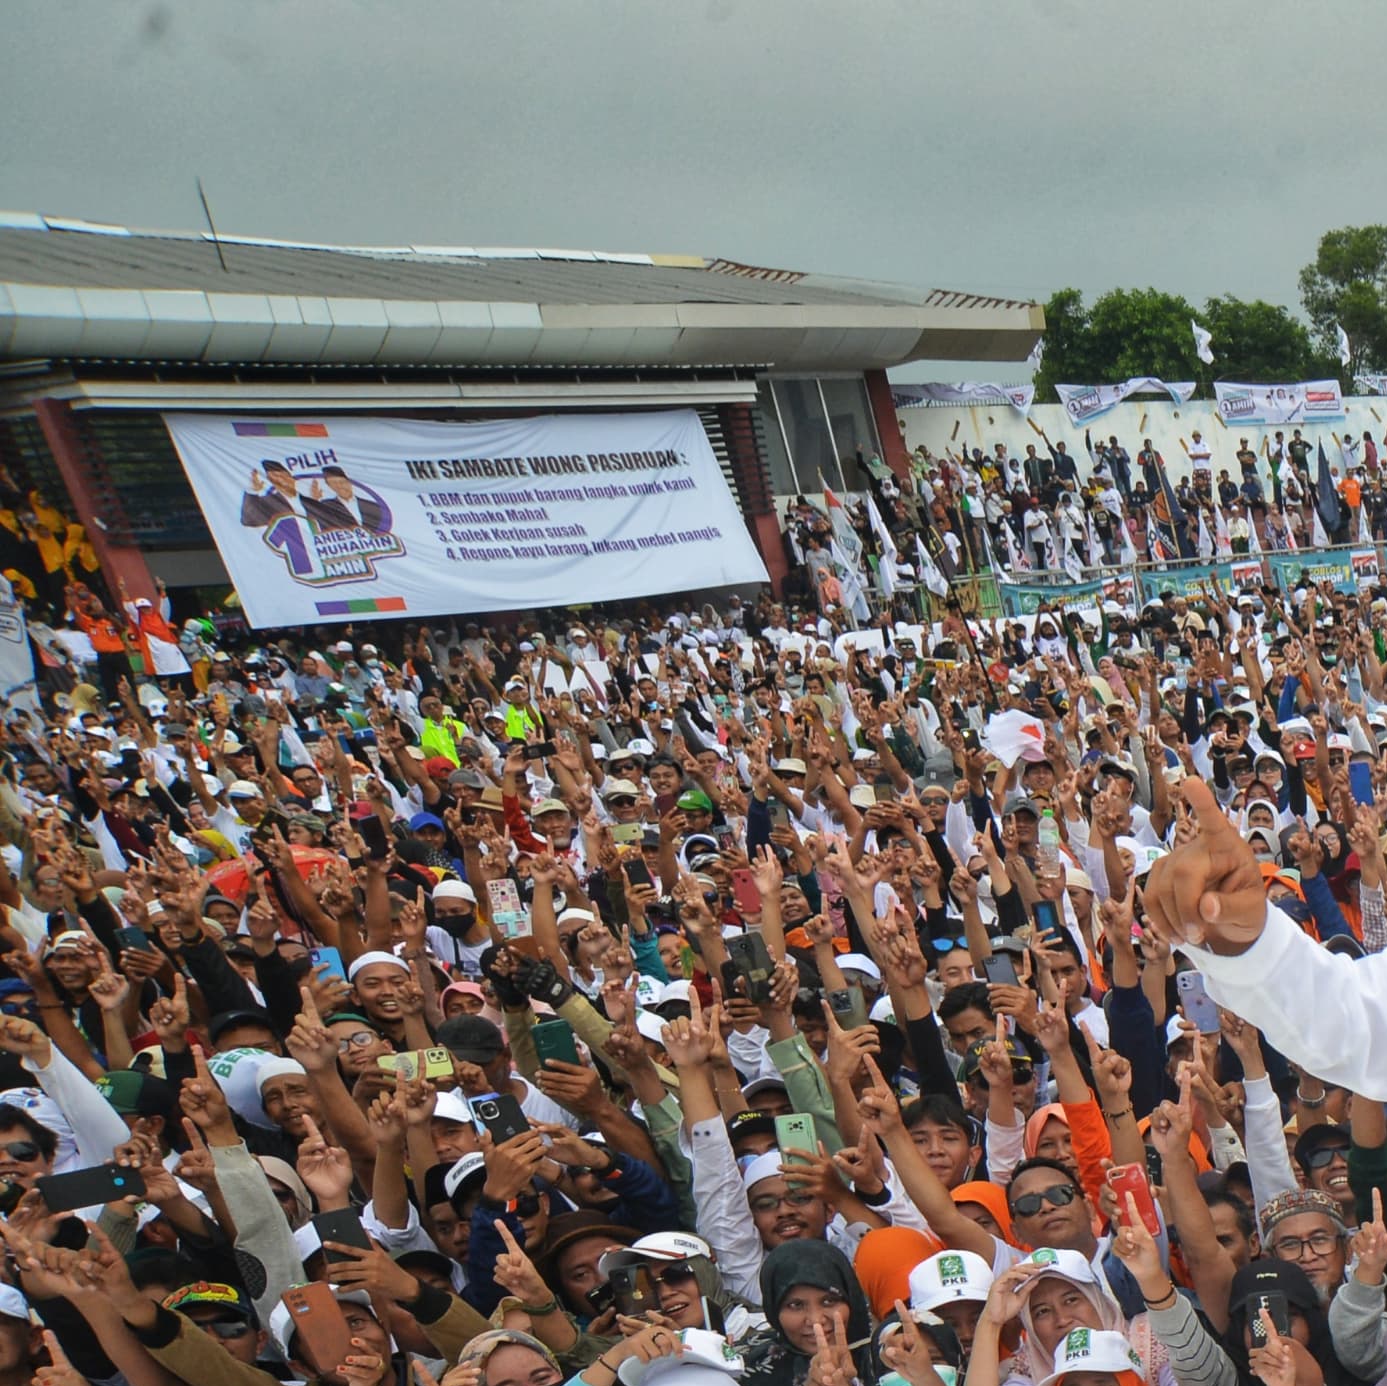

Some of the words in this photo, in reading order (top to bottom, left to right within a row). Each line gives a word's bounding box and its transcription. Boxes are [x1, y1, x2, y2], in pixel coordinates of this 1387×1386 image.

[285, 448, 338, 471] PILIH
[405, 460, 439, 480] IKI
[437, 457, 529, 480] SAMBATE
[526, 453, 587, 477] WONG
[586, 449, 680, 475] PASURUAN
[416, 493, 431, 508] 1.
[429, 491, 464, 508] BBM
[462, 491, 492, 507] dan
[490, 489, 537, 507] pupuk
[533, 488, 585, 502] barang
[582, 484, 629, 500] langka
[662, 476, 698, 492] kami
[426, 511, 443, 526] 2.
[440, 509, 508, 526] Sembako
[503, 506, 550, 522] Mahal
[313, 528, 354, 546] ANIES
[355, 527, 367, 540] &
[435, 528, 452, 543] 3.
[450, 527, 494, 543] Golek
[489, 526, 547, 543] Kerjoan
[544, 523, 588, 538] susah
[268, 516, 313, 575] 1
[316, 536, 393, 558] MUHAIMIN
[445, 547, 462, 562] 4.
[458, 545, 515, 563] Regone
[510, 544, 545, 561] kayu
[677, 525, 723, 543] nangis
[326, 558, 368, 578] AMIN
[941, 1277, 968, 1288] PKB
[1065, 1350, 1090, 1361] PKB
